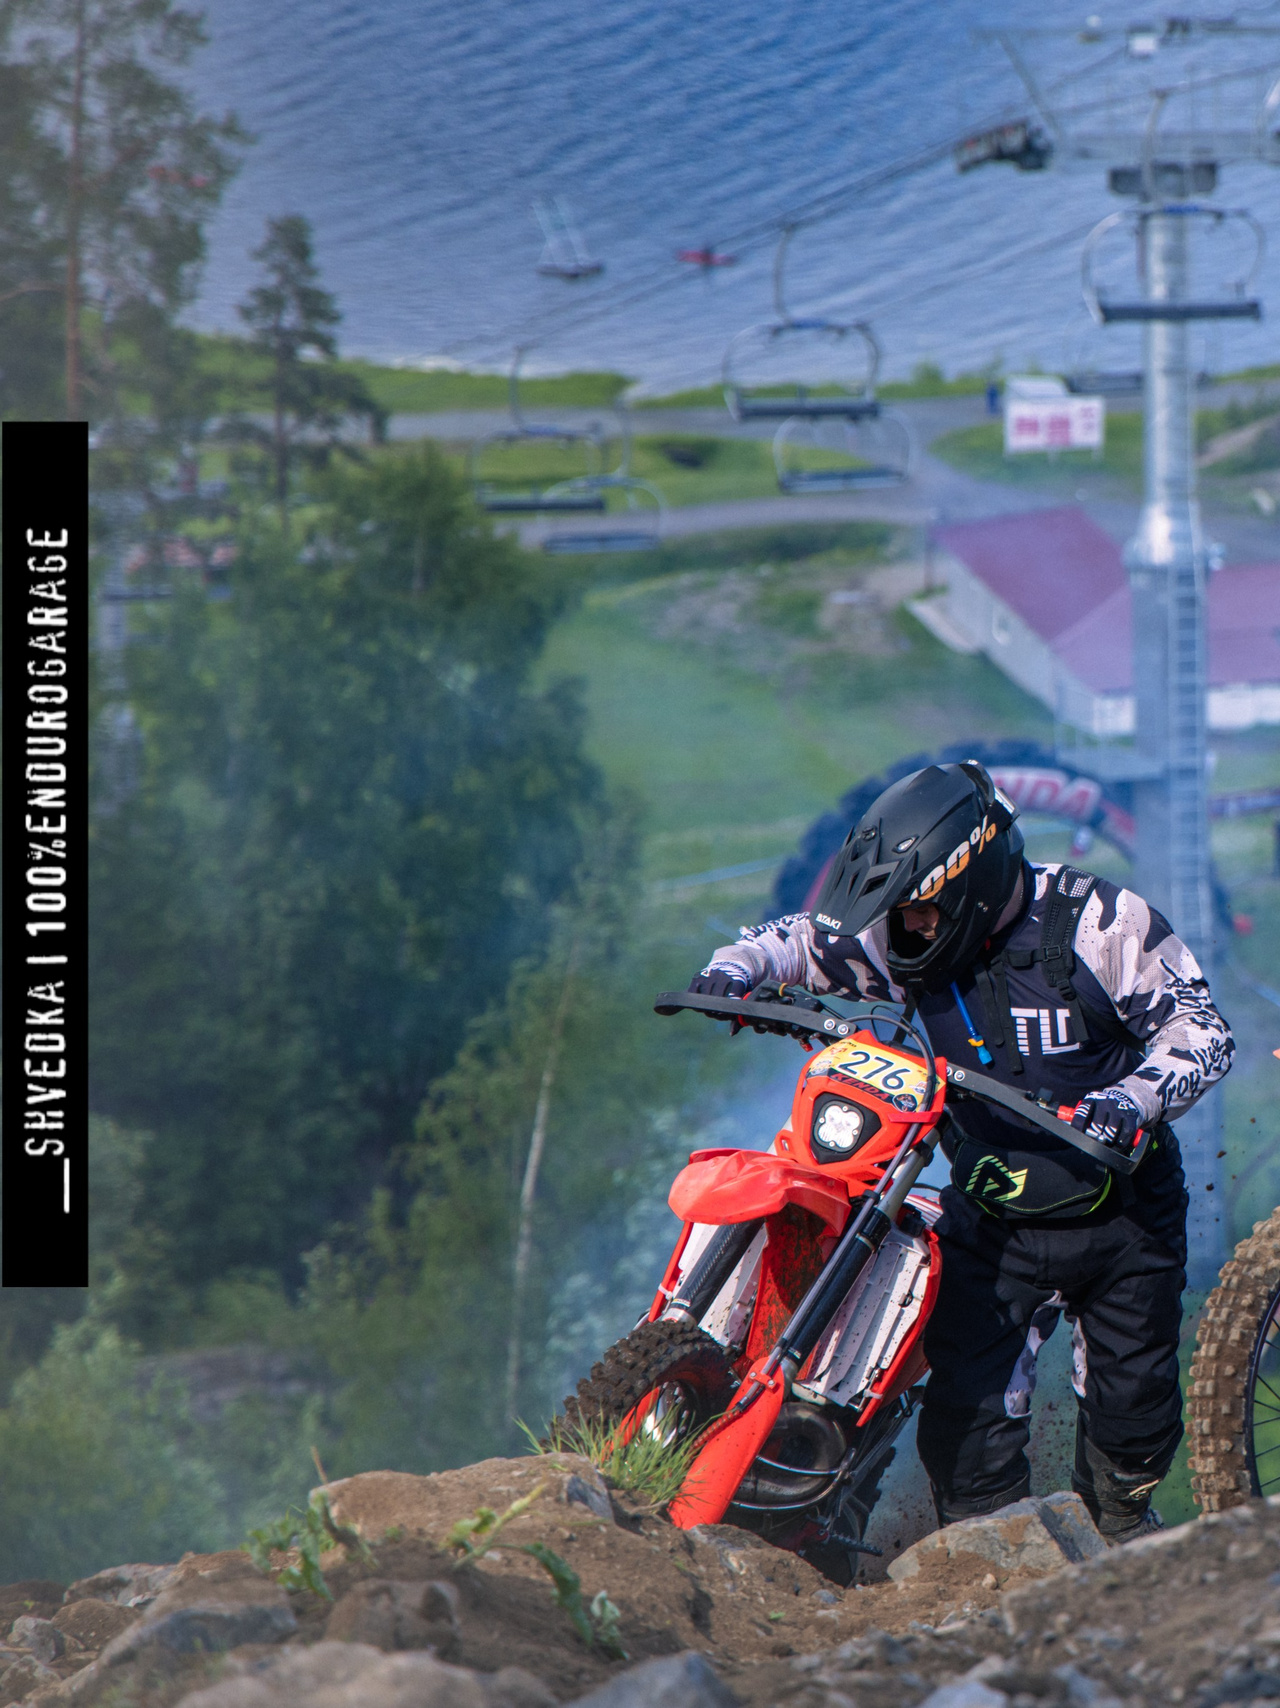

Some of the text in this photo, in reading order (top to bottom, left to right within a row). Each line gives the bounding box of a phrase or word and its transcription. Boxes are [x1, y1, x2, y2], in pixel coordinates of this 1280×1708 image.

[815, 913, 842, 930] ATAKI
[829, 1072, 891, 1101] KENDA
[837, 1050, 912, 1091] 276
[1155, 1068, 1200, 1110] Troy
